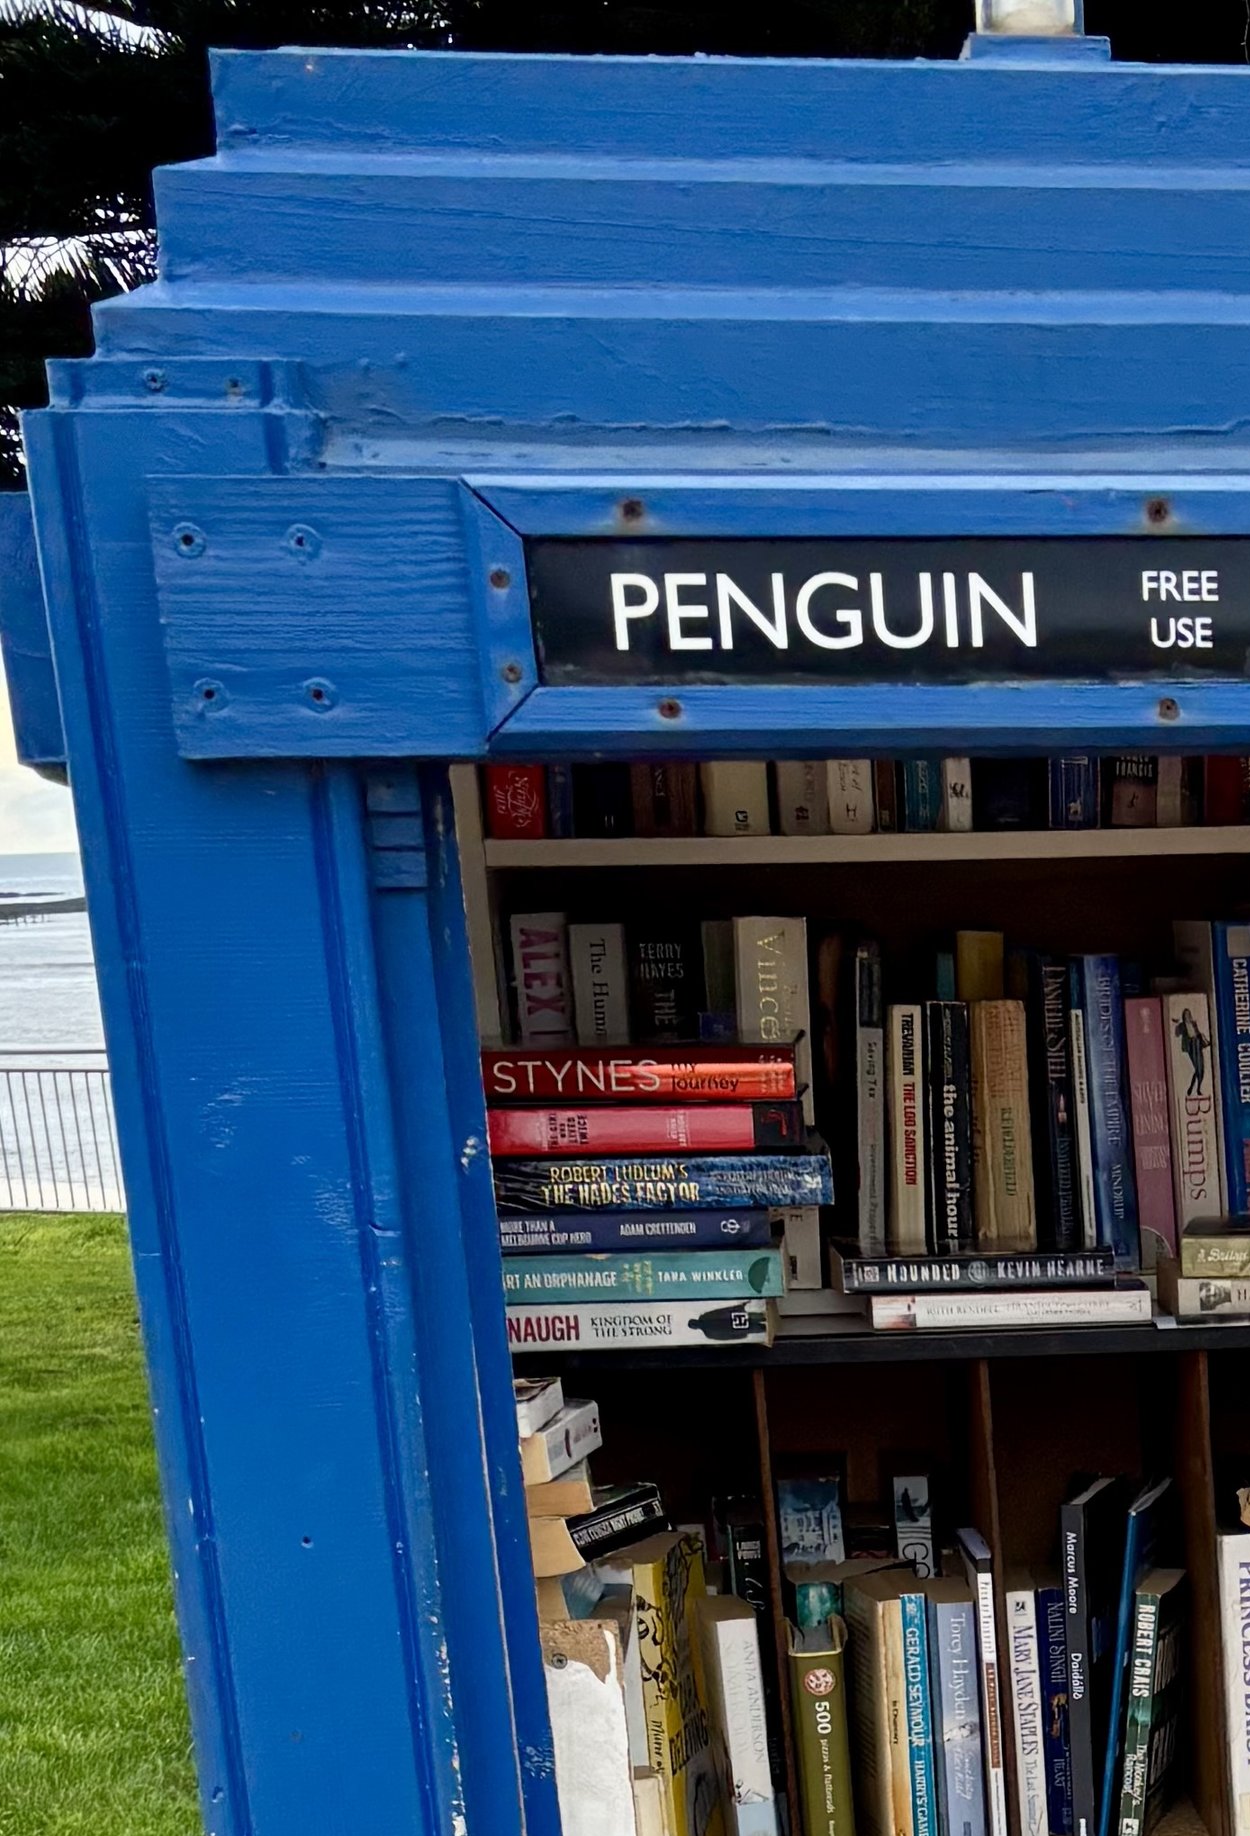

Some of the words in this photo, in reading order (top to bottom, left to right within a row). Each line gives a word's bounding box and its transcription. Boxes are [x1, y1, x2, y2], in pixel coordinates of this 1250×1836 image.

[1143, 571, 1219, 601] FREE
[609, 572, 1038, 651] PENGUIN
[1150, 618, 1213, 648] USE
[590, 937, 606, 974] The
[640, 943, 682, 960] TERRY
[519, 927, 566, 1017] ALEX
[641, 964, 684, 979] HAYES
[653, 989, 676, 1026] THE
[492, 1059, 661, 1094] STYNES
[943, 1084, 957, 1117] the
[944, 1121, 959, 1190] animal
[1183, 1095, 1212, 1200] Bumps
[550, 1166, 607, 1183] ROBERT
[541, 1186, 574, 1205] THE
[579, 1185, 629, 1203] HADES
[637, 1183, 700, 1201] FACTOR
[620, 1225, 642, 1236] ADAM
[946, 1193, 958, 1241] hour
[524, 1274, 541, 1288] AN
[544, 1272, 617, 1288] ORPHANAGE
[887, 1263, 960, 1282] HOUNDED
[997, 1262, 1041, 1279] KEVIN
[1047, 1259, 1105, 1277] HEARNE
[1065, 1531, 1078, 1574] Marcus
[1067, 1577, 1078, 1615] Moore
[949, 1614, 966, 1656] Torey
[1047, 1601, 1064, 1645] NALINI
[1133, 1603, 1156, 1653] ROBERT
[905, 1627, 921, 1683] GERALD
[1012, 1625, 1032, 1665] MARY
[953, 1660, 967, 1721] Hayden
[1014, 1667, 1036, 1700] JANE
[1132, 1658, 1151, 1698] CRAIS
[814, 1701, 832, 1734] 500
[907, 1684, 925, 1749] SEYMOUR
[1018, 1701, 1041, 1756] STAPLES
